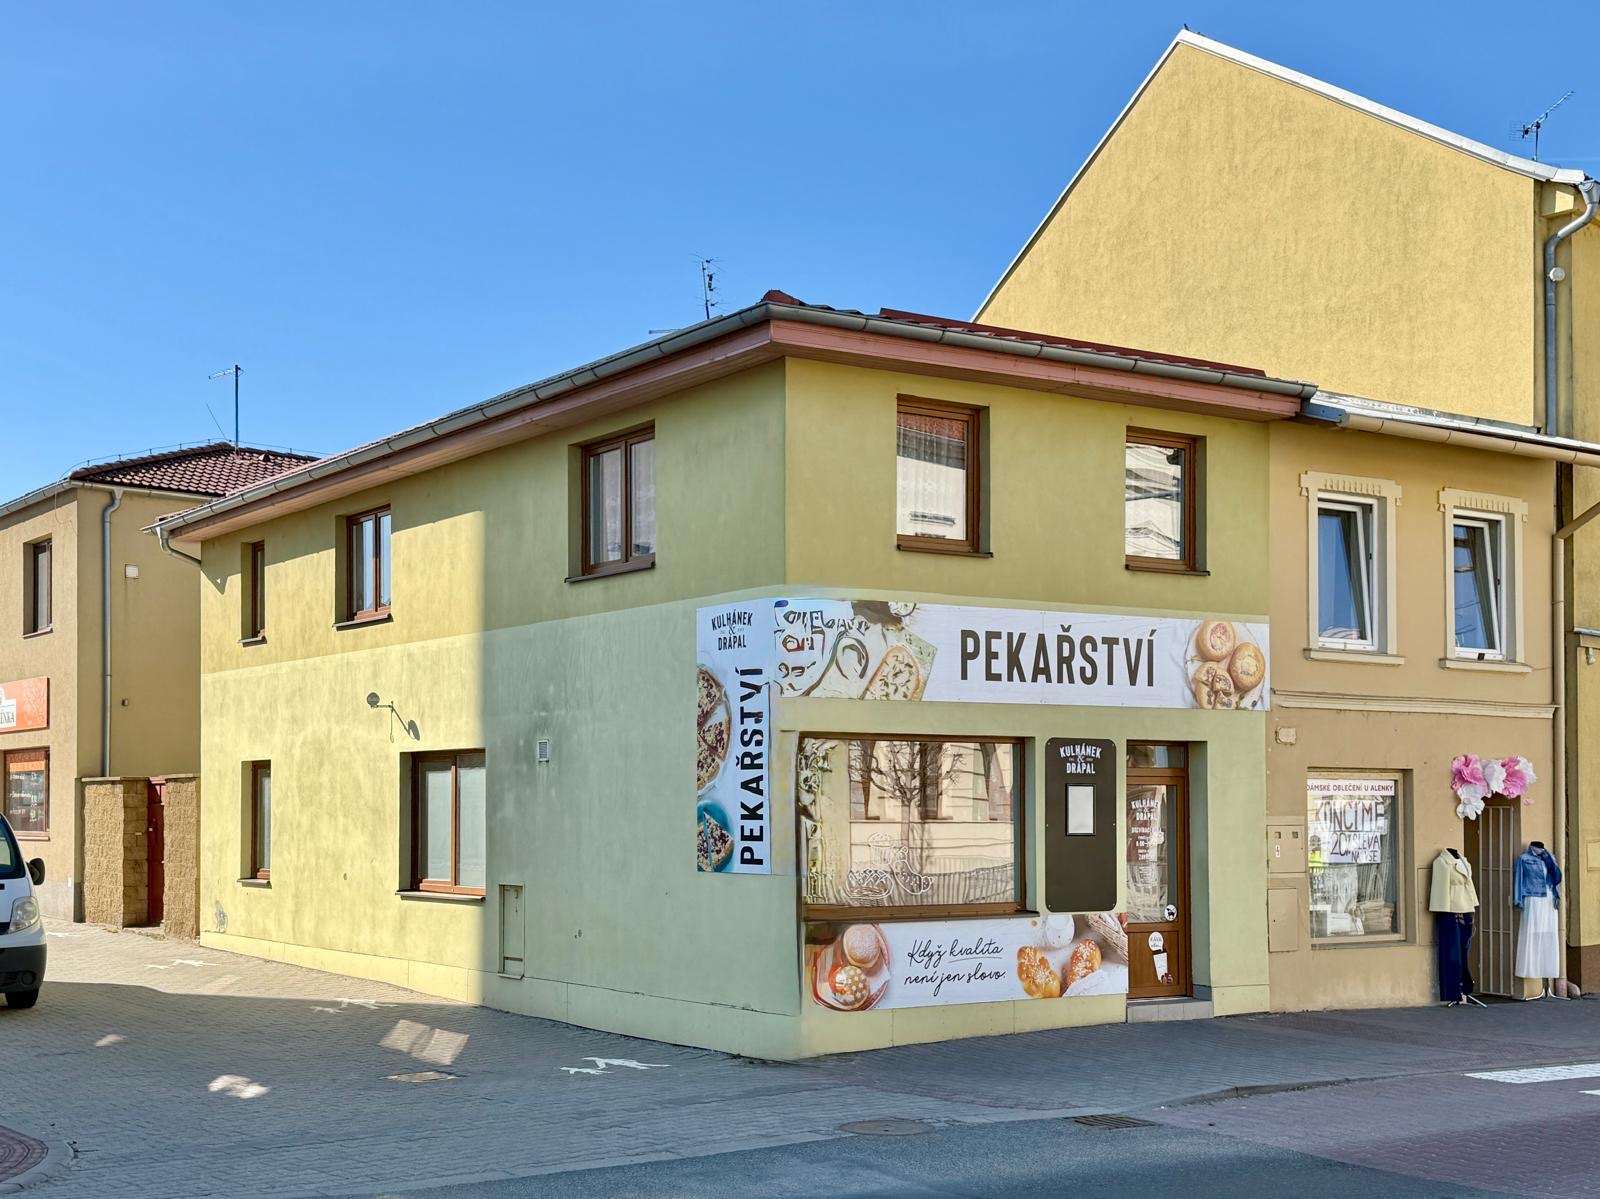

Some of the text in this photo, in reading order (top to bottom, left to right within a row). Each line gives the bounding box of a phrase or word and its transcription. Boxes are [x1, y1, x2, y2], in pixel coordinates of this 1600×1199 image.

[711, 609, 753, 631] KULHÁNEK
[718, 634, 747, 651] DRÁPAL
[960, 624, 1158, 687] PEKAŘSTVÍ
[1059, 743, 1102, 759] KULHÁNEK
[1077, 754, 1085, 763] &
[735, 667, 764, 866] PEKAŘSTVÍ
[1066, 761, 1096, 774] DRÁPAL
[1333, 782, 1363, 792] OBLEČENÍ
[1364, 784, 1369, 792] U
[1370, 784, 1394, 792] ALENKY
[907, 936, 1004, 968] Když kvalita
[904, 970, 937, 986] není
[932, 970, 966, 998] jen
